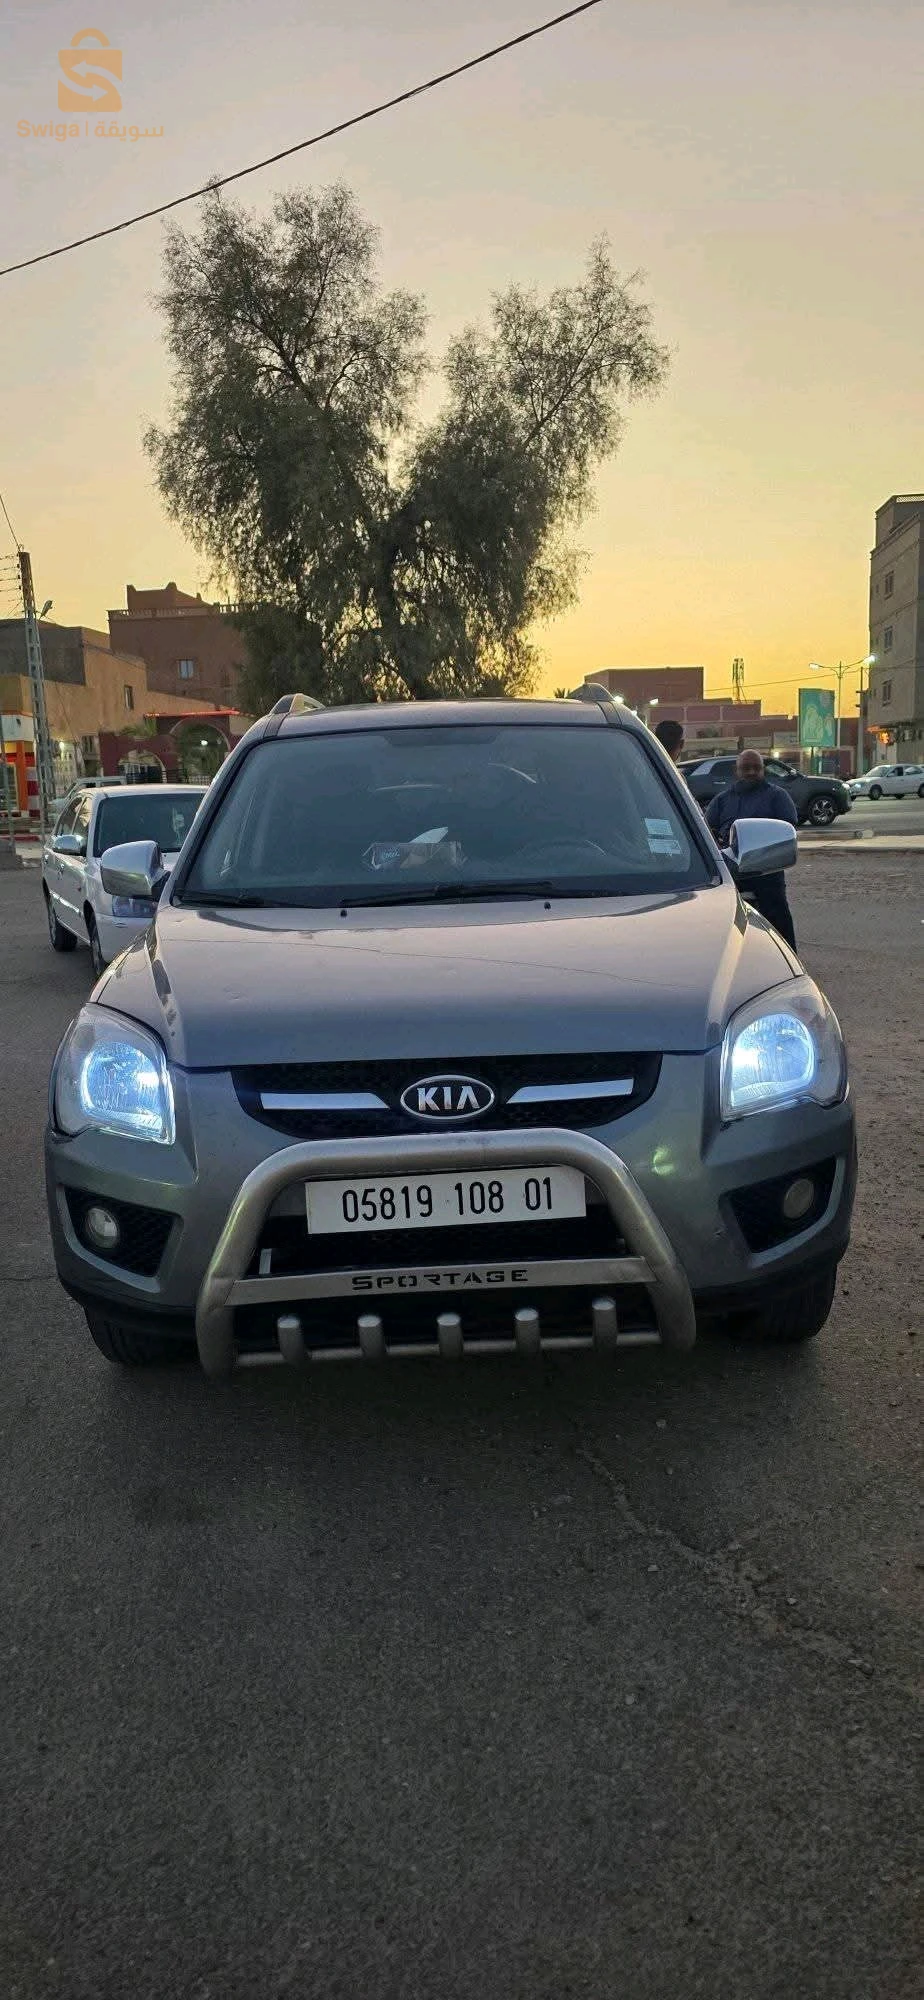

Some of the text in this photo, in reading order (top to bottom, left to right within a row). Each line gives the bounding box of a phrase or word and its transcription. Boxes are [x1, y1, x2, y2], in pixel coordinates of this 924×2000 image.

[416, 1087, 480, 1111] KIA
[342, 1176, 553, 1223] 05819 108 01
[351, 1269, 529, 1290] SPORTAGE
